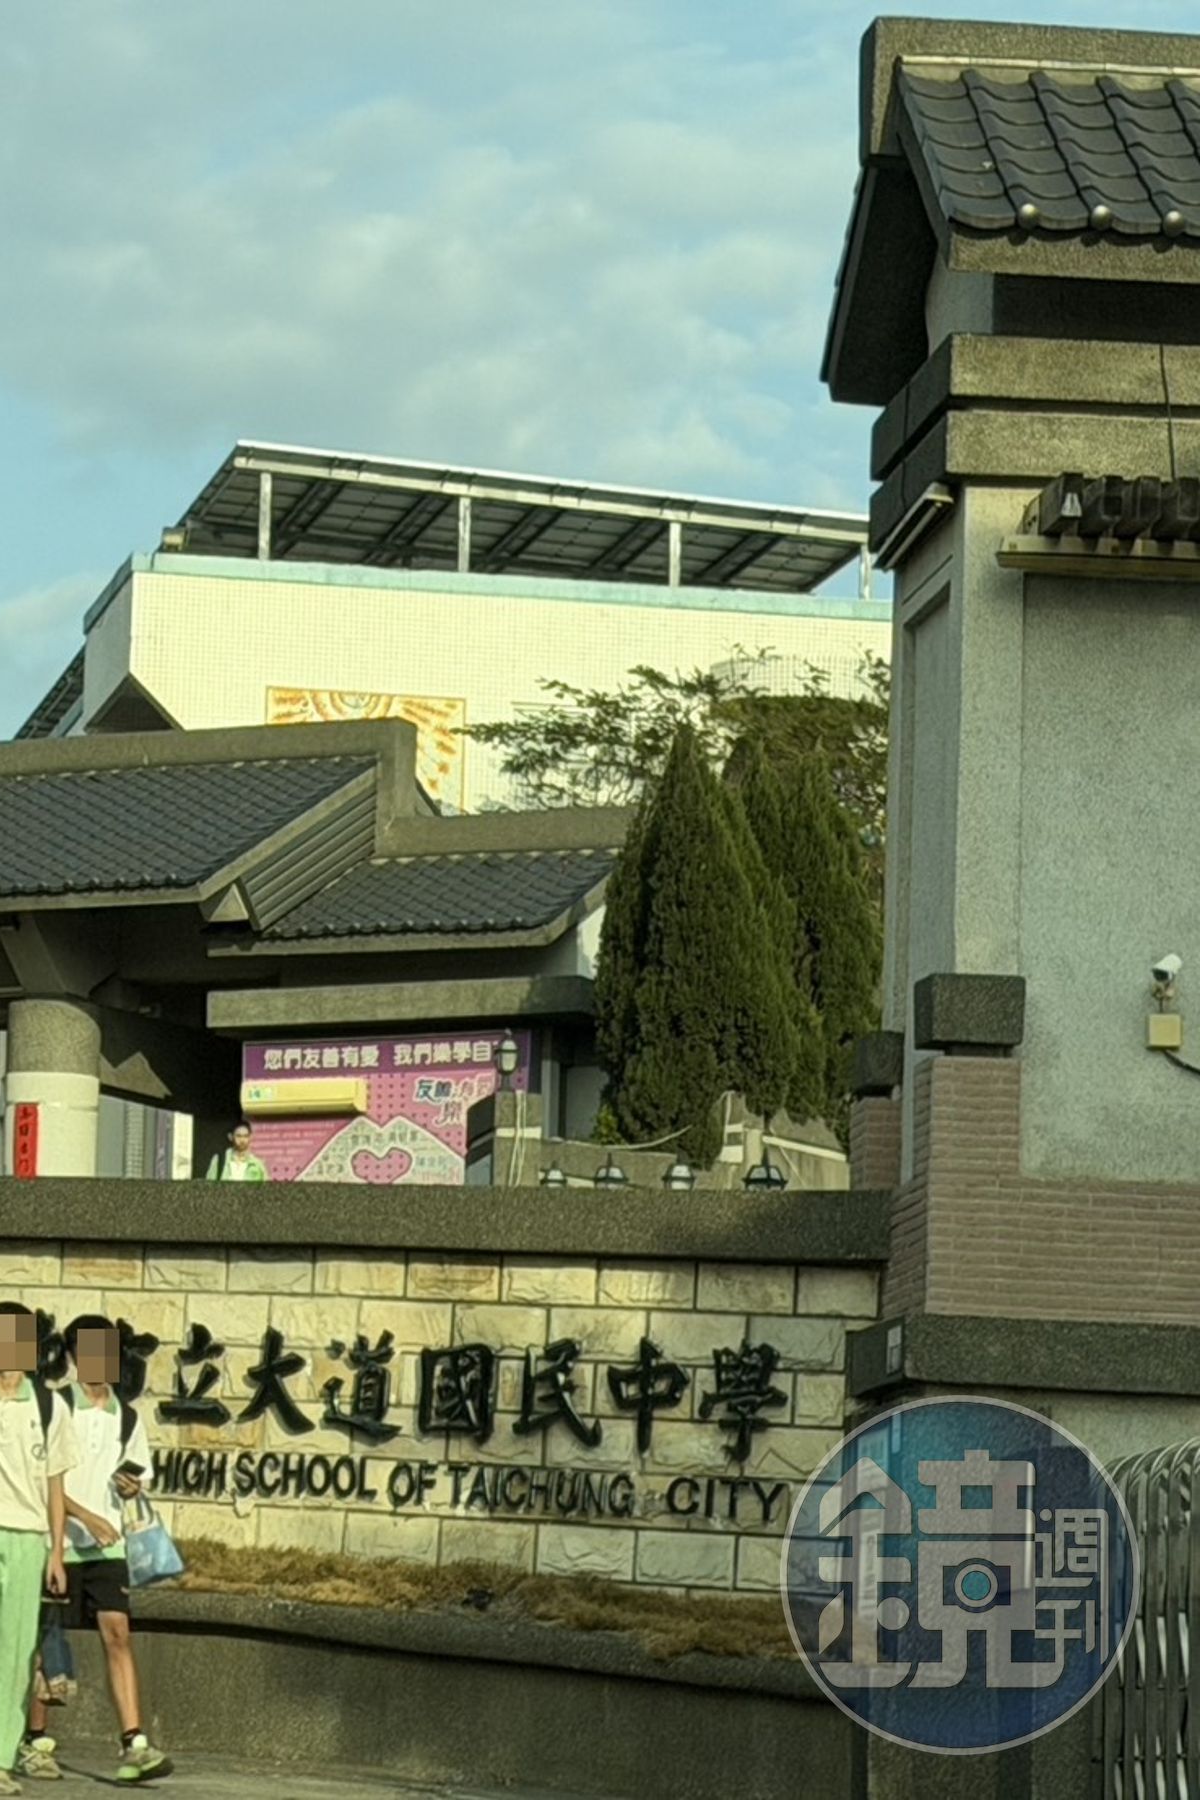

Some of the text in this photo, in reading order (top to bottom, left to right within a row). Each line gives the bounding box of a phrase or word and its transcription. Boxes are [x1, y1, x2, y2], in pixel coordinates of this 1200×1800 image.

[393, 1040, 500, 1067] 我們樂學自
[150, 1449, 788, 1523] HIGH SCHOOL OF TAICHUNG CITY
